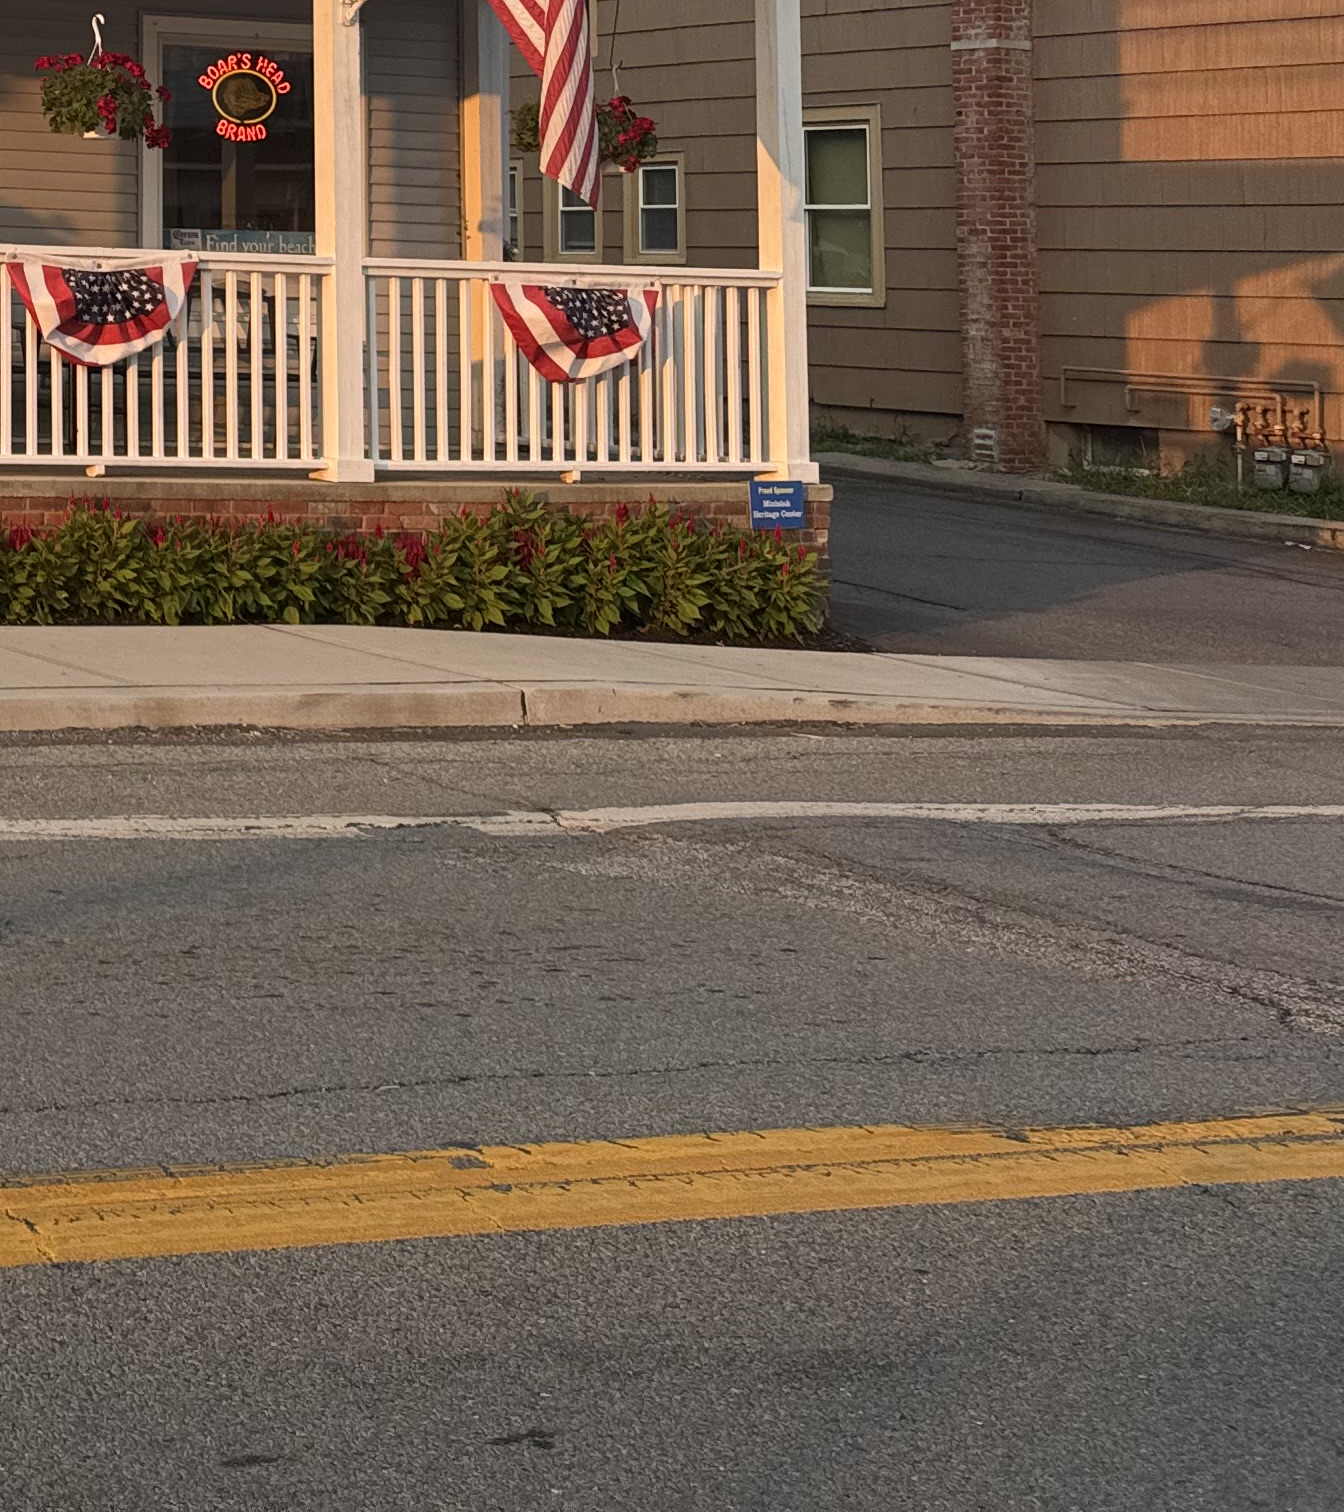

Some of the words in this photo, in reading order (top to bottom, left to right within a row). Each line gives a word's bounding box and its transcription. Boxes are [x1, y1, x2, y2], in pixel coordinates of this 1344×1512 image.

[198, 53, 252, 90] BOAR'S
[255, 55, 292, 94] HEAD
[216, 119, 267, 142] BRAND
[206, 233, 238, 252] Find
[242, 240, 274, 254] your
[752, 510, 780, 519] Heritage
[780, 510, 803, 518] Center
